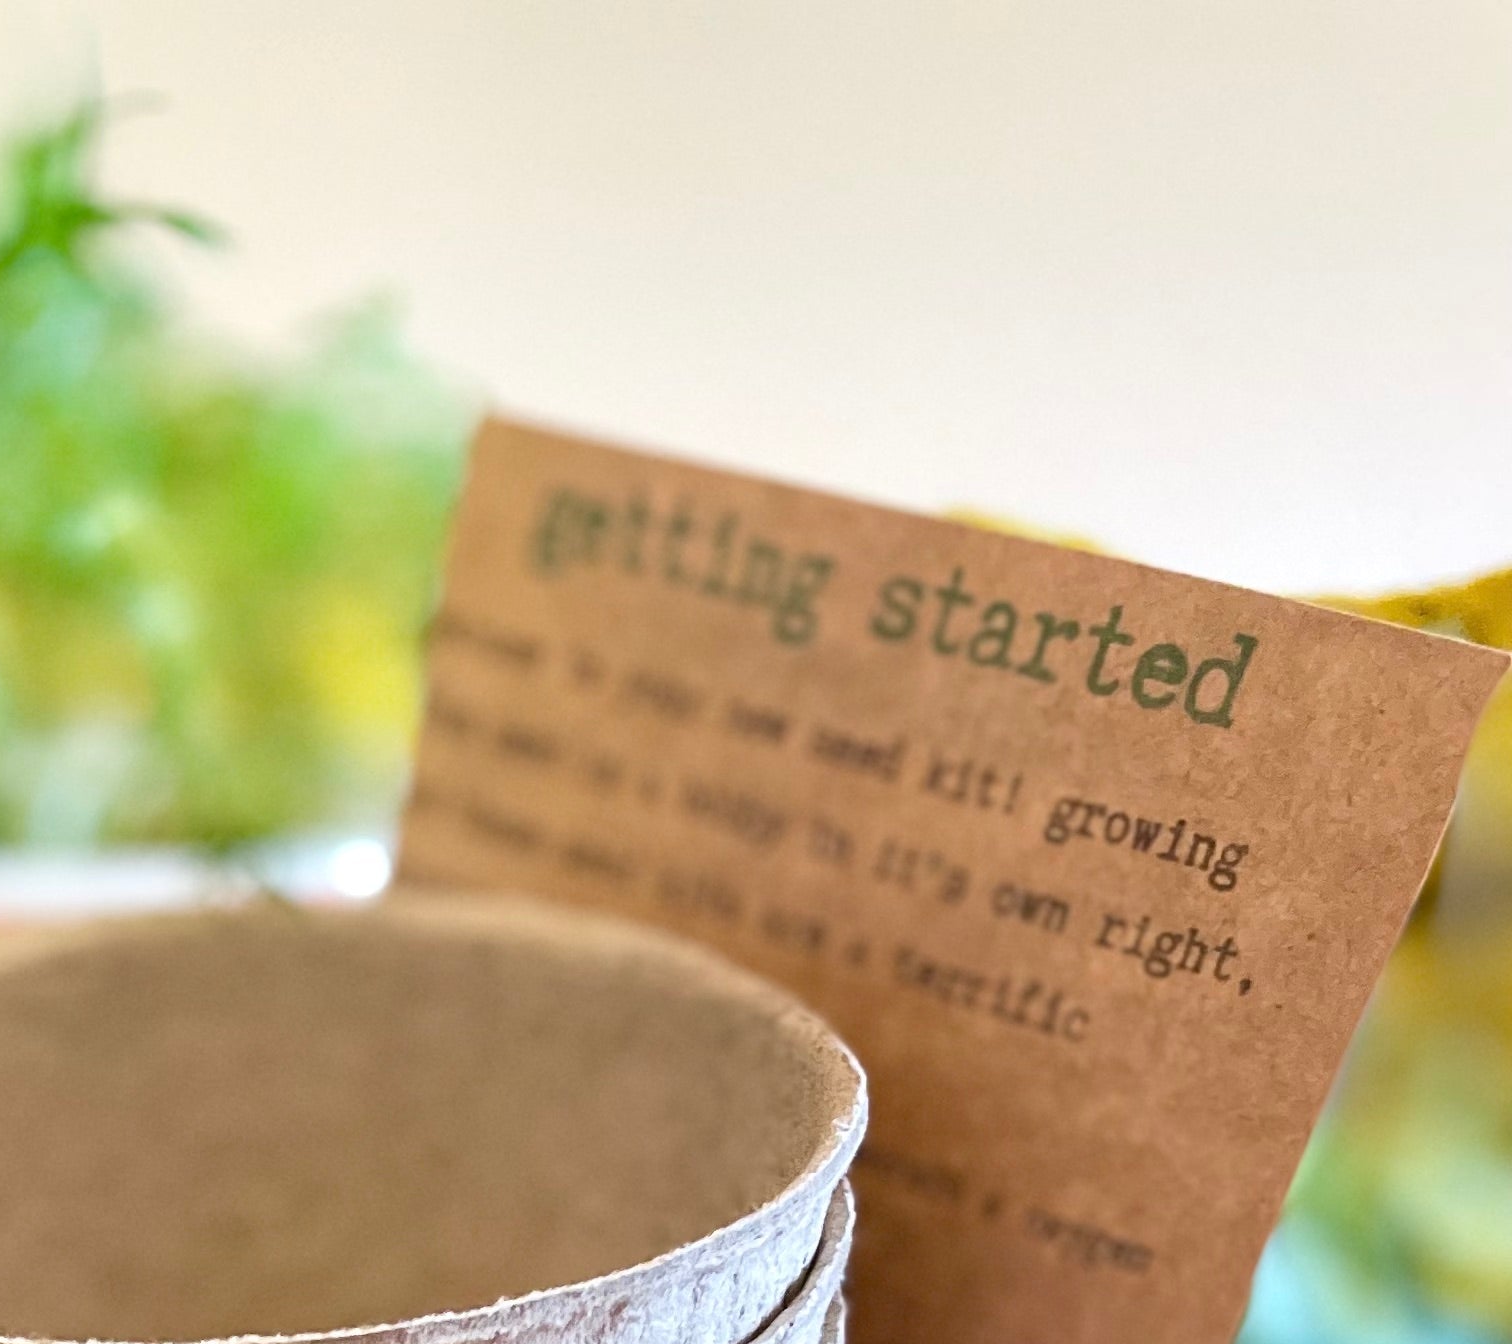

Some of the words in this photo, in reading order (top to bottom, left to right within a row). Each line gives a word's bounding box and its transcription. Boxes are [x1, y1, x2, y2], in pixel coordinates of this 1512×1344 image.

[532, 486, 834, 648] getting
[868, 566, 1259, 730] started
[922, 750, 1024, 816] kit!
[1043, 797, 1250, 893] growing
[876, 838, 970, 902] it's
[991, 880, 1072, 934] own
[1094, 912, 1254, 997] right,
[894, 944, 1092, 1043] terrific
